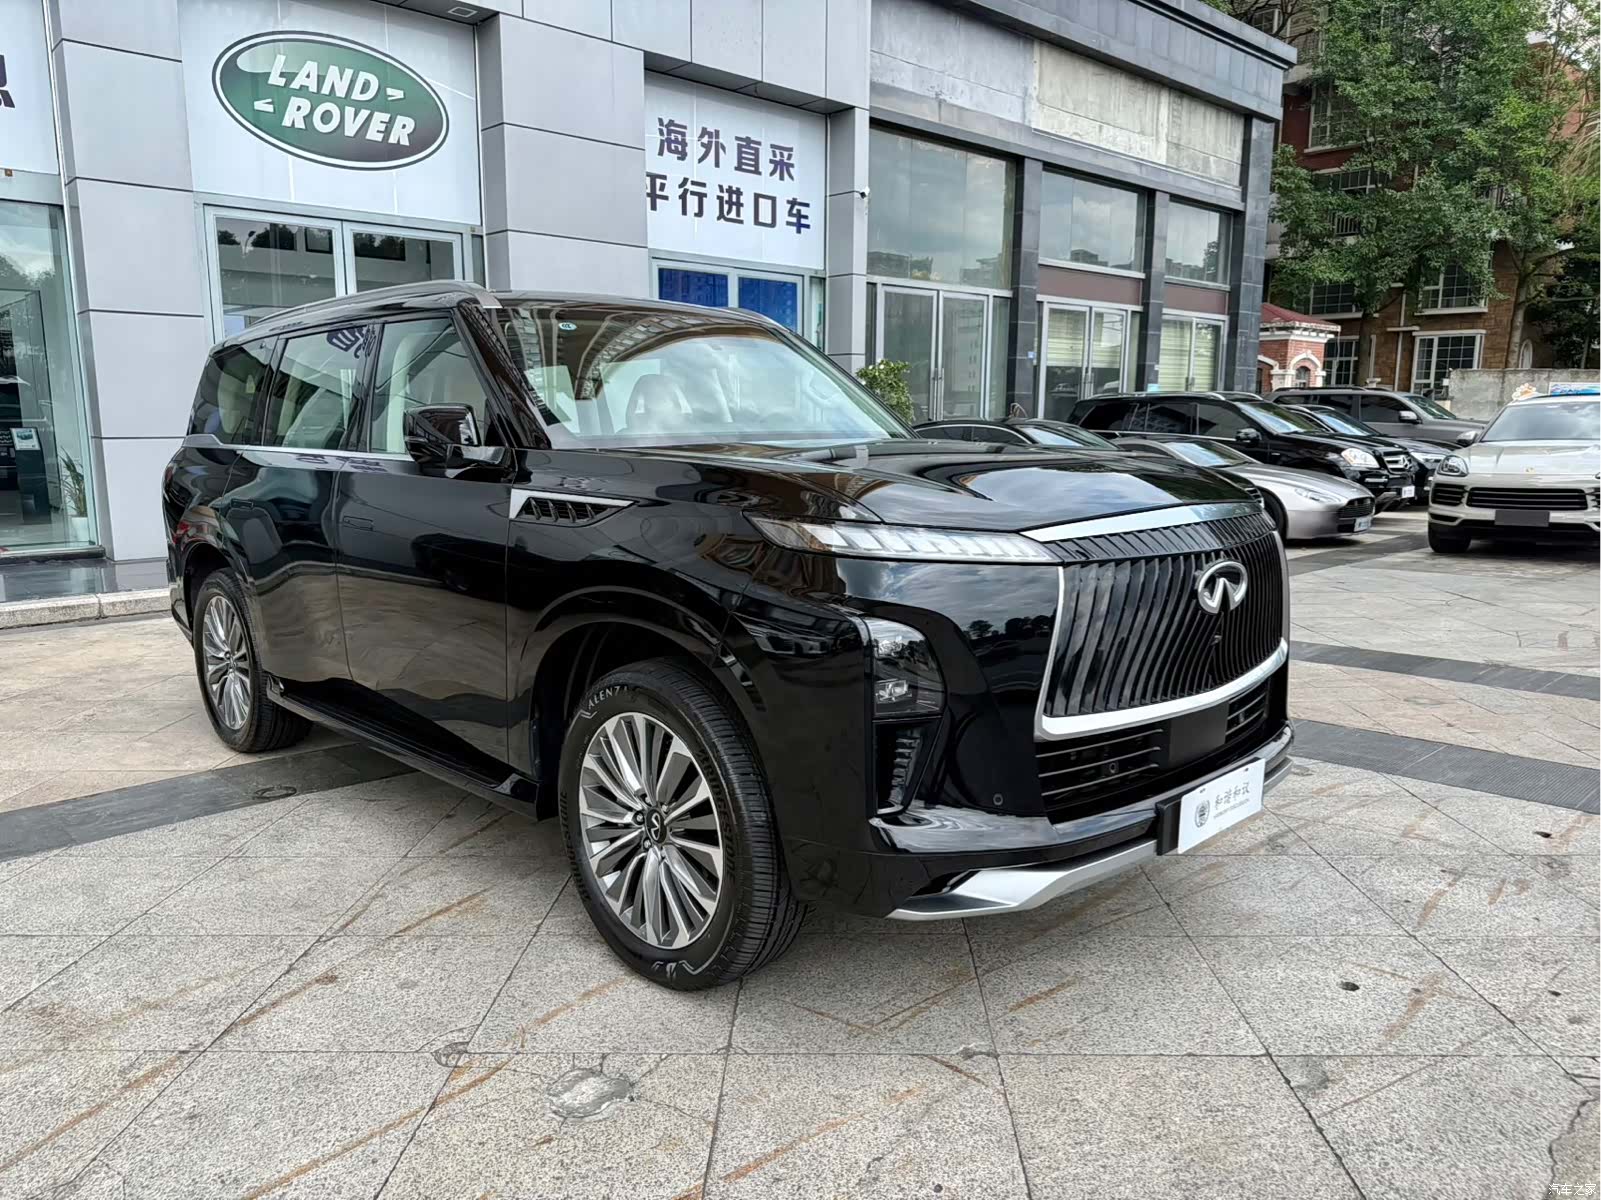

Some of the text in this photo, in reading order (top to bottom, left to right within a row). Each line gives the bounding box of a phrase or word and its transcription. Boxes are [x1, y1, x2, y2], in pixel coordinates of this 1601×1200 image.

[267, 54, 380, 102] LAND
[281, 97, 416, 147] ROVER
[657, 117, 796, 182] 海外直采
[645, 171, 811, 235] 平行进口车
